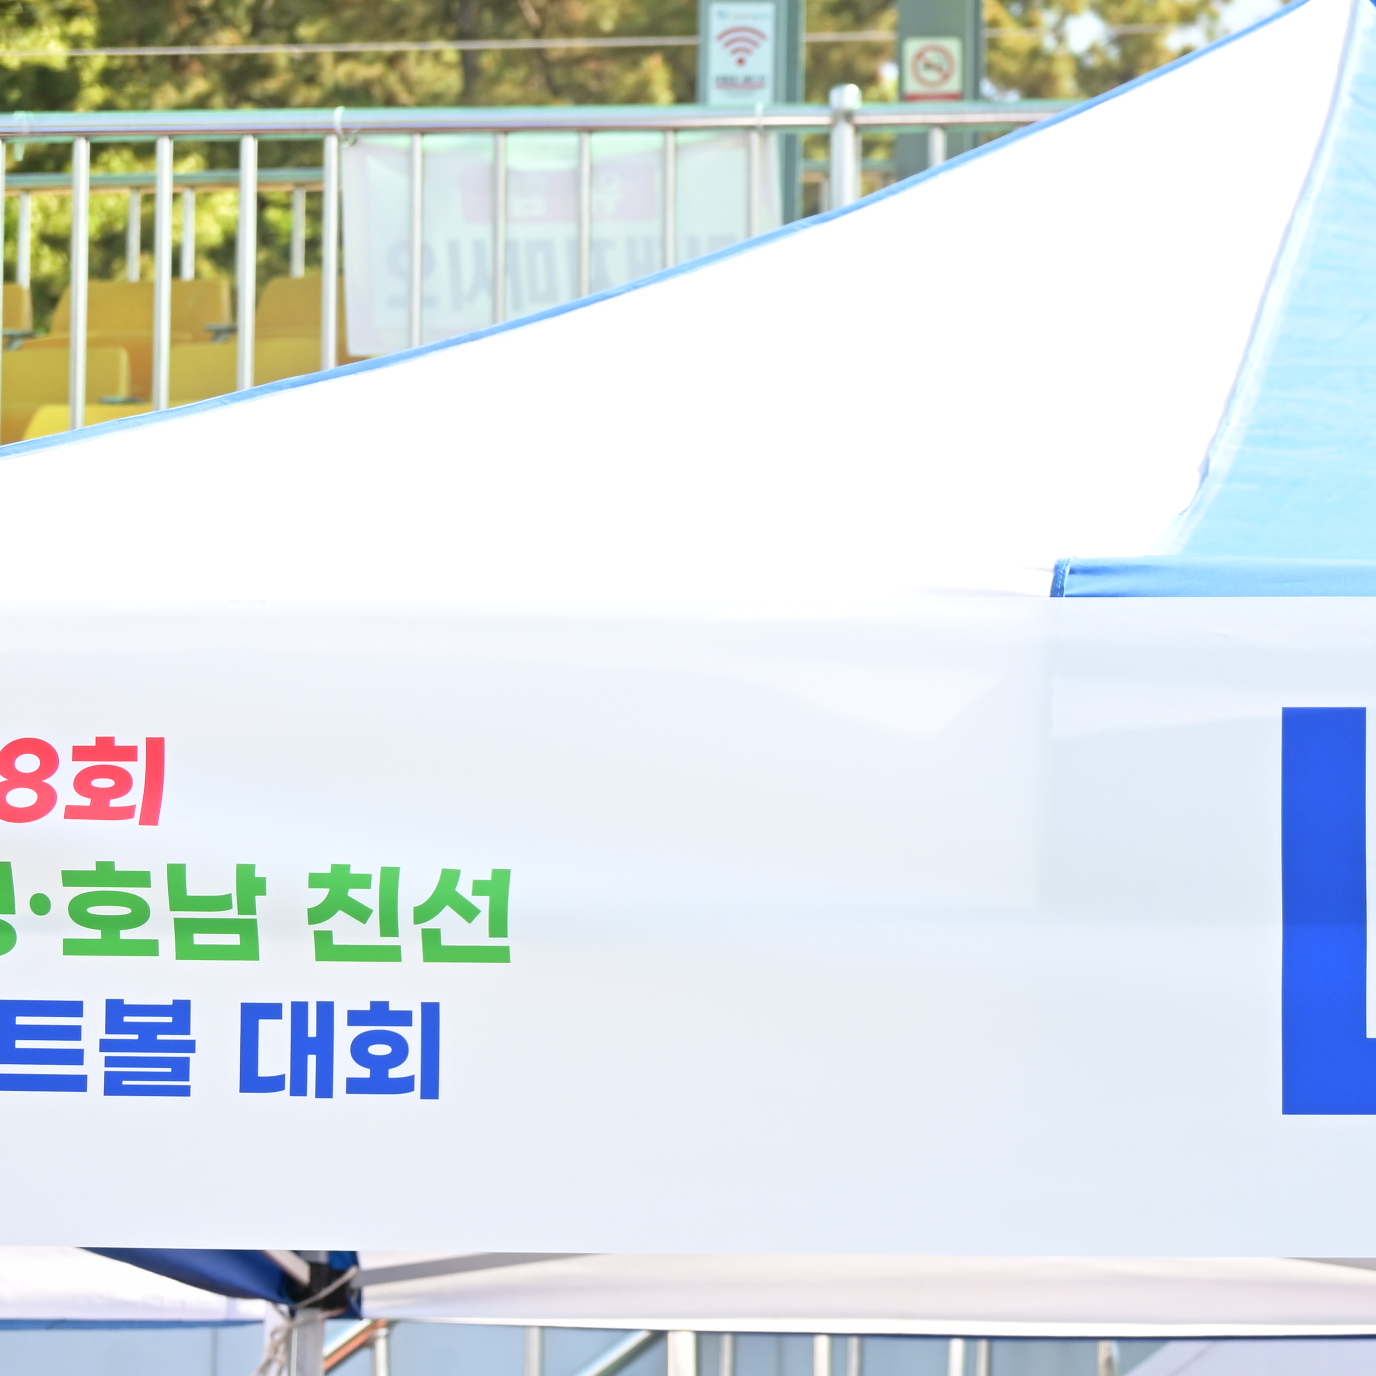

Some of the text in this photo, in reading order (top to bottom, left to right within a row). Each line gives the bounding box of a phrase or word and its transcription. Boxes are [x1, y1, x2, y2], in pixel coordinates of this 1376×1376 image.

[0, 736, 166, 826] 8회
[0, 861, 511, 963] ·호남 친선
[0, 999, 441, 1099] 트볼 대회
